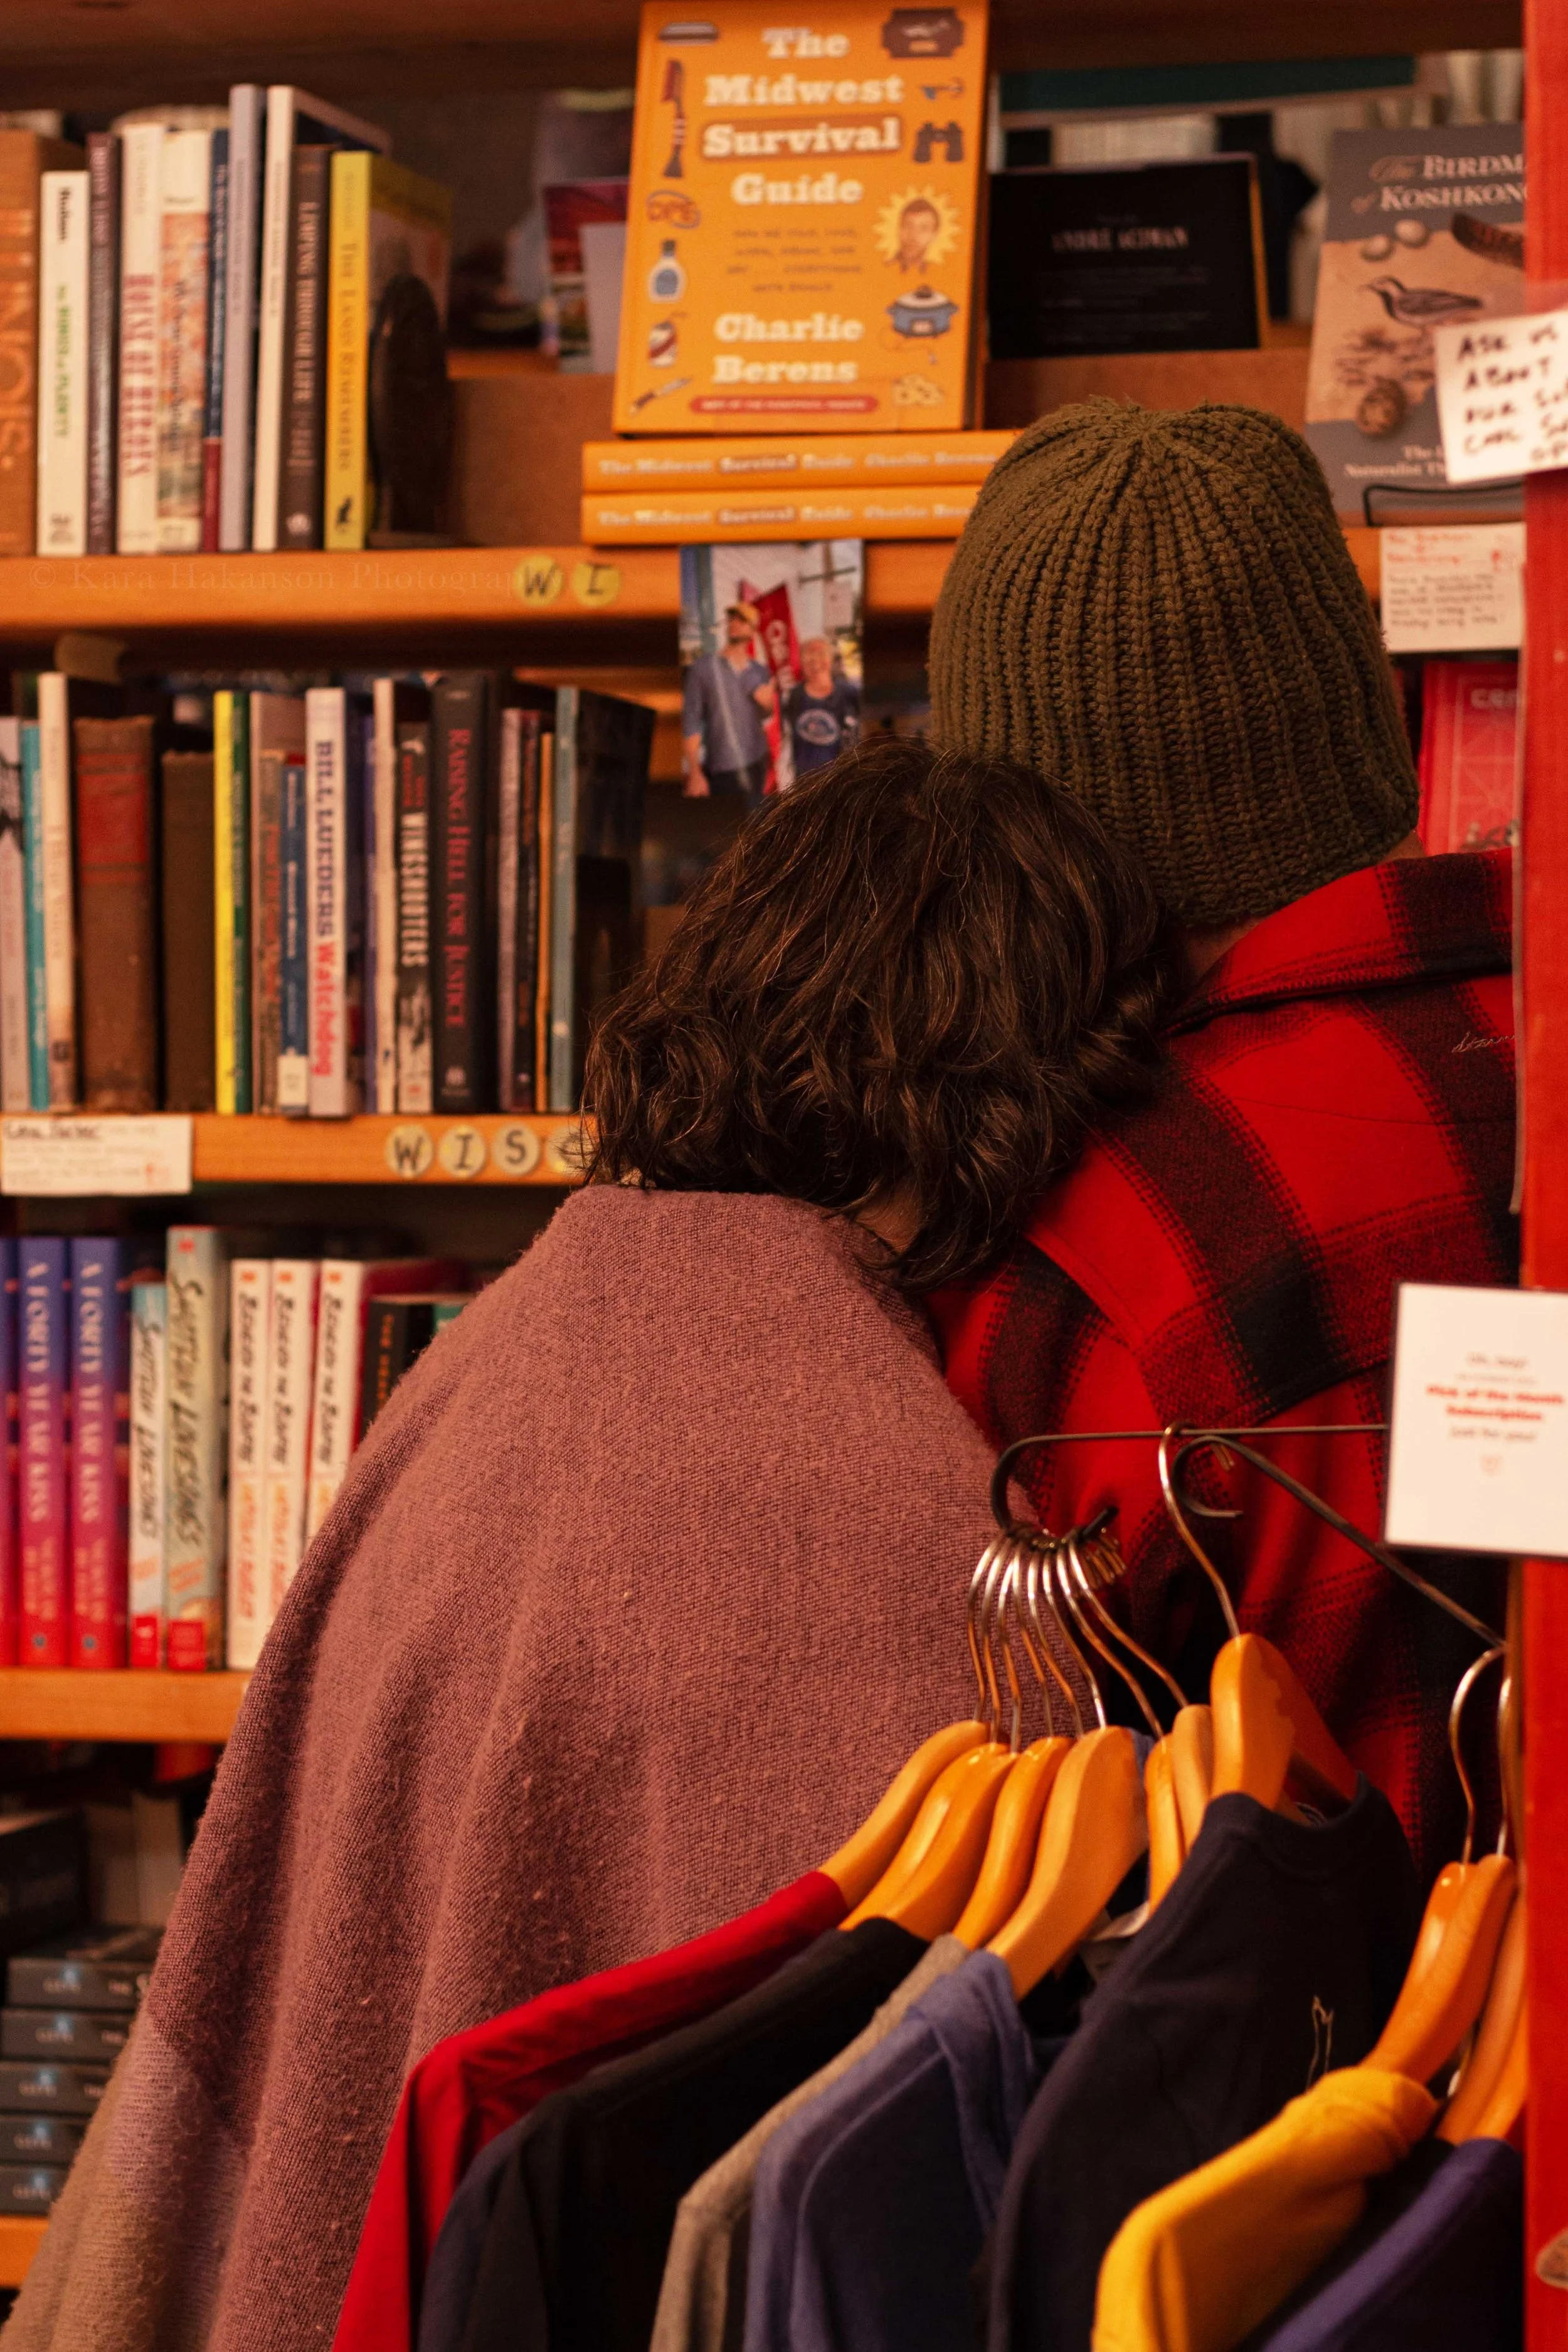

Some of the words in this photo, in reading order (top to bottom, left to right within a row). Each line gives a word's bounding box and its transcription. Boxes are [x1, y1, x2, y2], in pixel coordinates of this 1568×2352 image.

[763, 28, 849, 58] The
[704, 74, 904, 107] Midwest
[702, 117, 901, 157] Survival
[731, 173, 864, 205] Guide
[714, 312, 865, 343] Charlie
[712, 354, 860, 385] Berens
[315, 740, 335, 804] BILL
[447, 728, 472, 820] RAISING
[315, 808, 336, 938] LUEDERS
[446, 825, 472, 886] HELL
[400, 811, 429, 967] WINGSHOOTERS
[446, 892, 468, 936] FOR
[310, 941, 337, 1077] Watchdog
[444, 945, 471, 1028] JUSTICE
[25, 1285, 51, 1374] FORTY
[79, 1285, 103, 1374] FORTY
[170, 1273, 204, 1392] SHOTGUN
[28, 1462, 51, 1523] KISS
[80, 1463, 103, 1524] KISS
[169, 1401, 204, 1545] LOVESONGS
